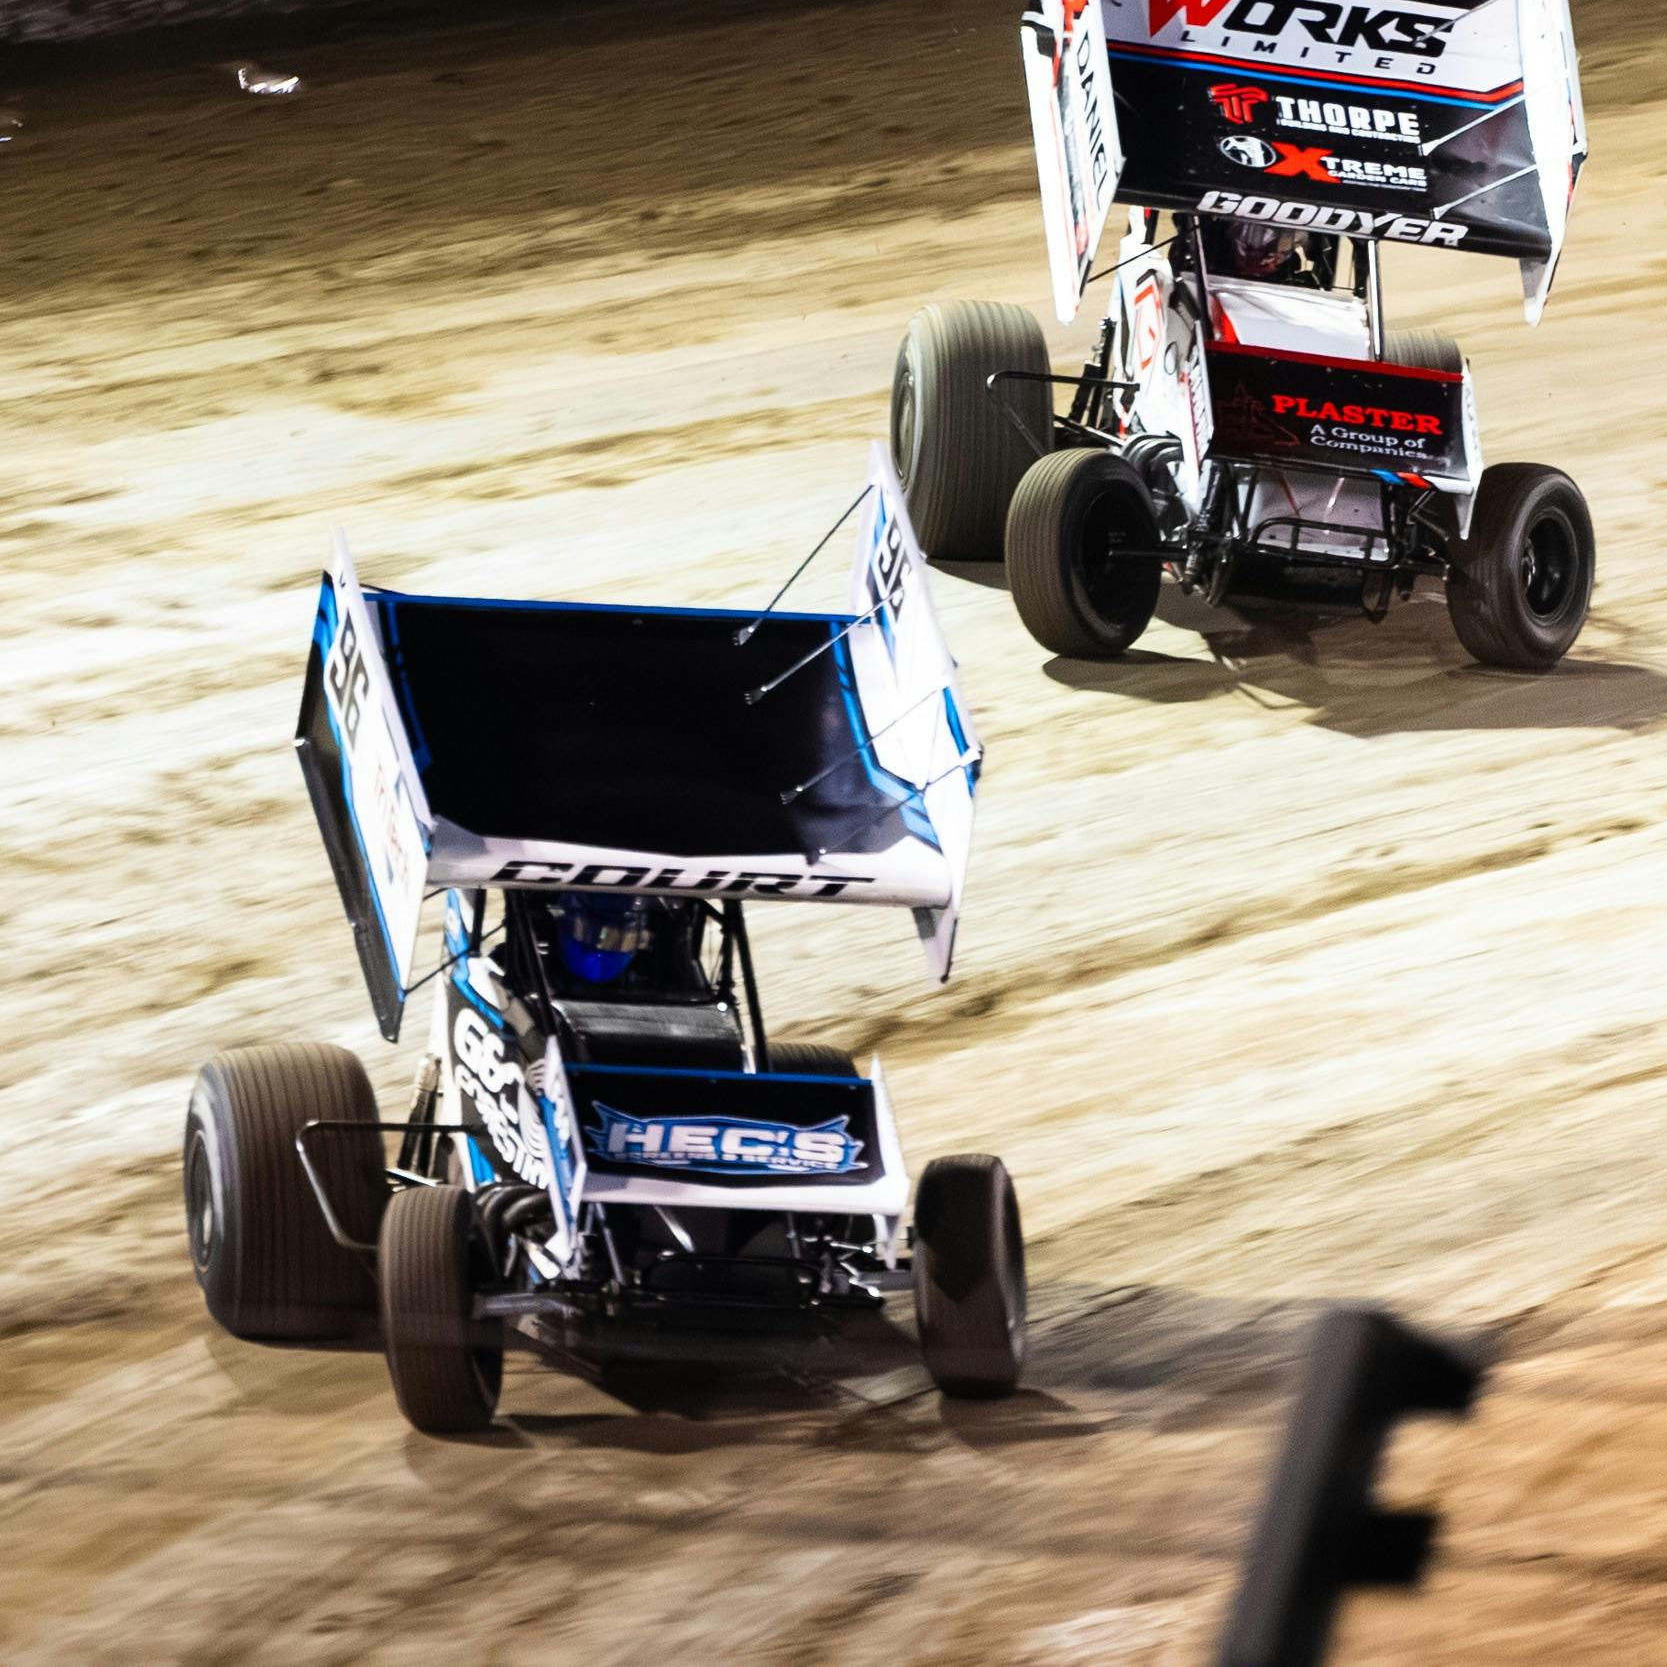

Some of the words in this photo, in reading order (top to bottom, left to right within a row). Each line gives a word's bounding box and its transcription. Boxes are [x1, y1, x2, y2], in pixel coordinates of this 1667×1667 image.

[1181, 30, 1437, 75] LIMITED
[1076, 29, 1112, 213] DANIEL
[1275, 96, 1420, 137] THORPE
[1264, 141, 1427, 184] XTREME
[1195, 190, 1469, 247] GOODYER
[1271, 394, 1443, 435] PLASTER
[1310, 424, 1324, 435] A
[1331, 426, 1399, 447] Group
[1404, 437, 1426, 449] of
[1310, 436, 1434, 459] Companies
[490, 860, 877, 897] COURT
[607, 1122, 847, 1163] HEC'S
